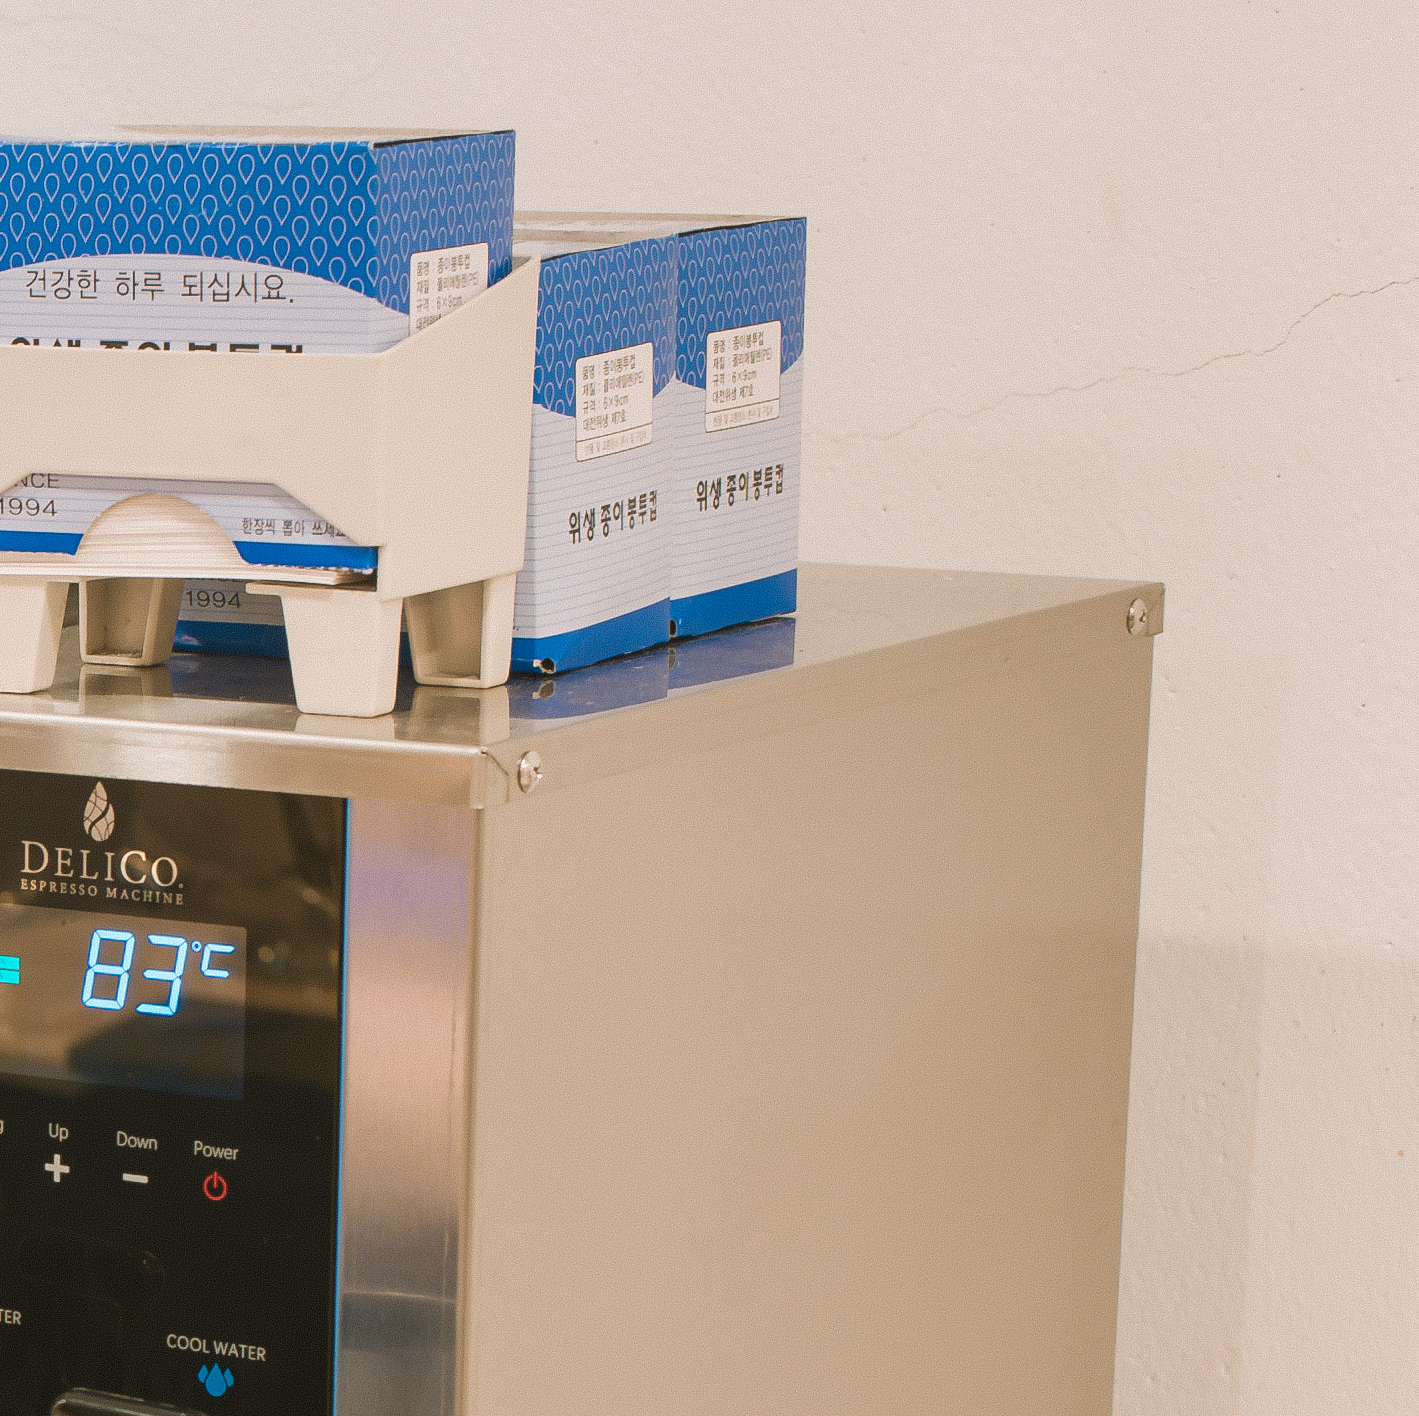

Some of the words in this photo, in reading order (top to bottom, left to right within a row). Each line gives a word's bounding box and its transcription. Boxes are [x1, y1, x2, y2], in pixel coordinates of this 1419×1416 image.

[25, 268, 99, 299] 건강한
[115, 271, 165, 301] 하루
[181, 271, 294, 304] 되십시요.
[696, 477, 722, 512] 위생
[242, 517, 276, 536] 한장씩
[282, 519, 305, 537] 뽑아
[568, 508, 596, 544] 위생
[185, 589, 242, 609] 1994
[20, 878, 99, 898] ESPRESSO
[106, 886, 185, 905] MACHINE
[48, 1122, 69, 1142] Up
[116, 1130, 158, 1151] Down
[193, 1140, 239, 1161] Power
[166, 1333, 210, 1354] COOL
[213, 1339, 267, 1362] WATER
